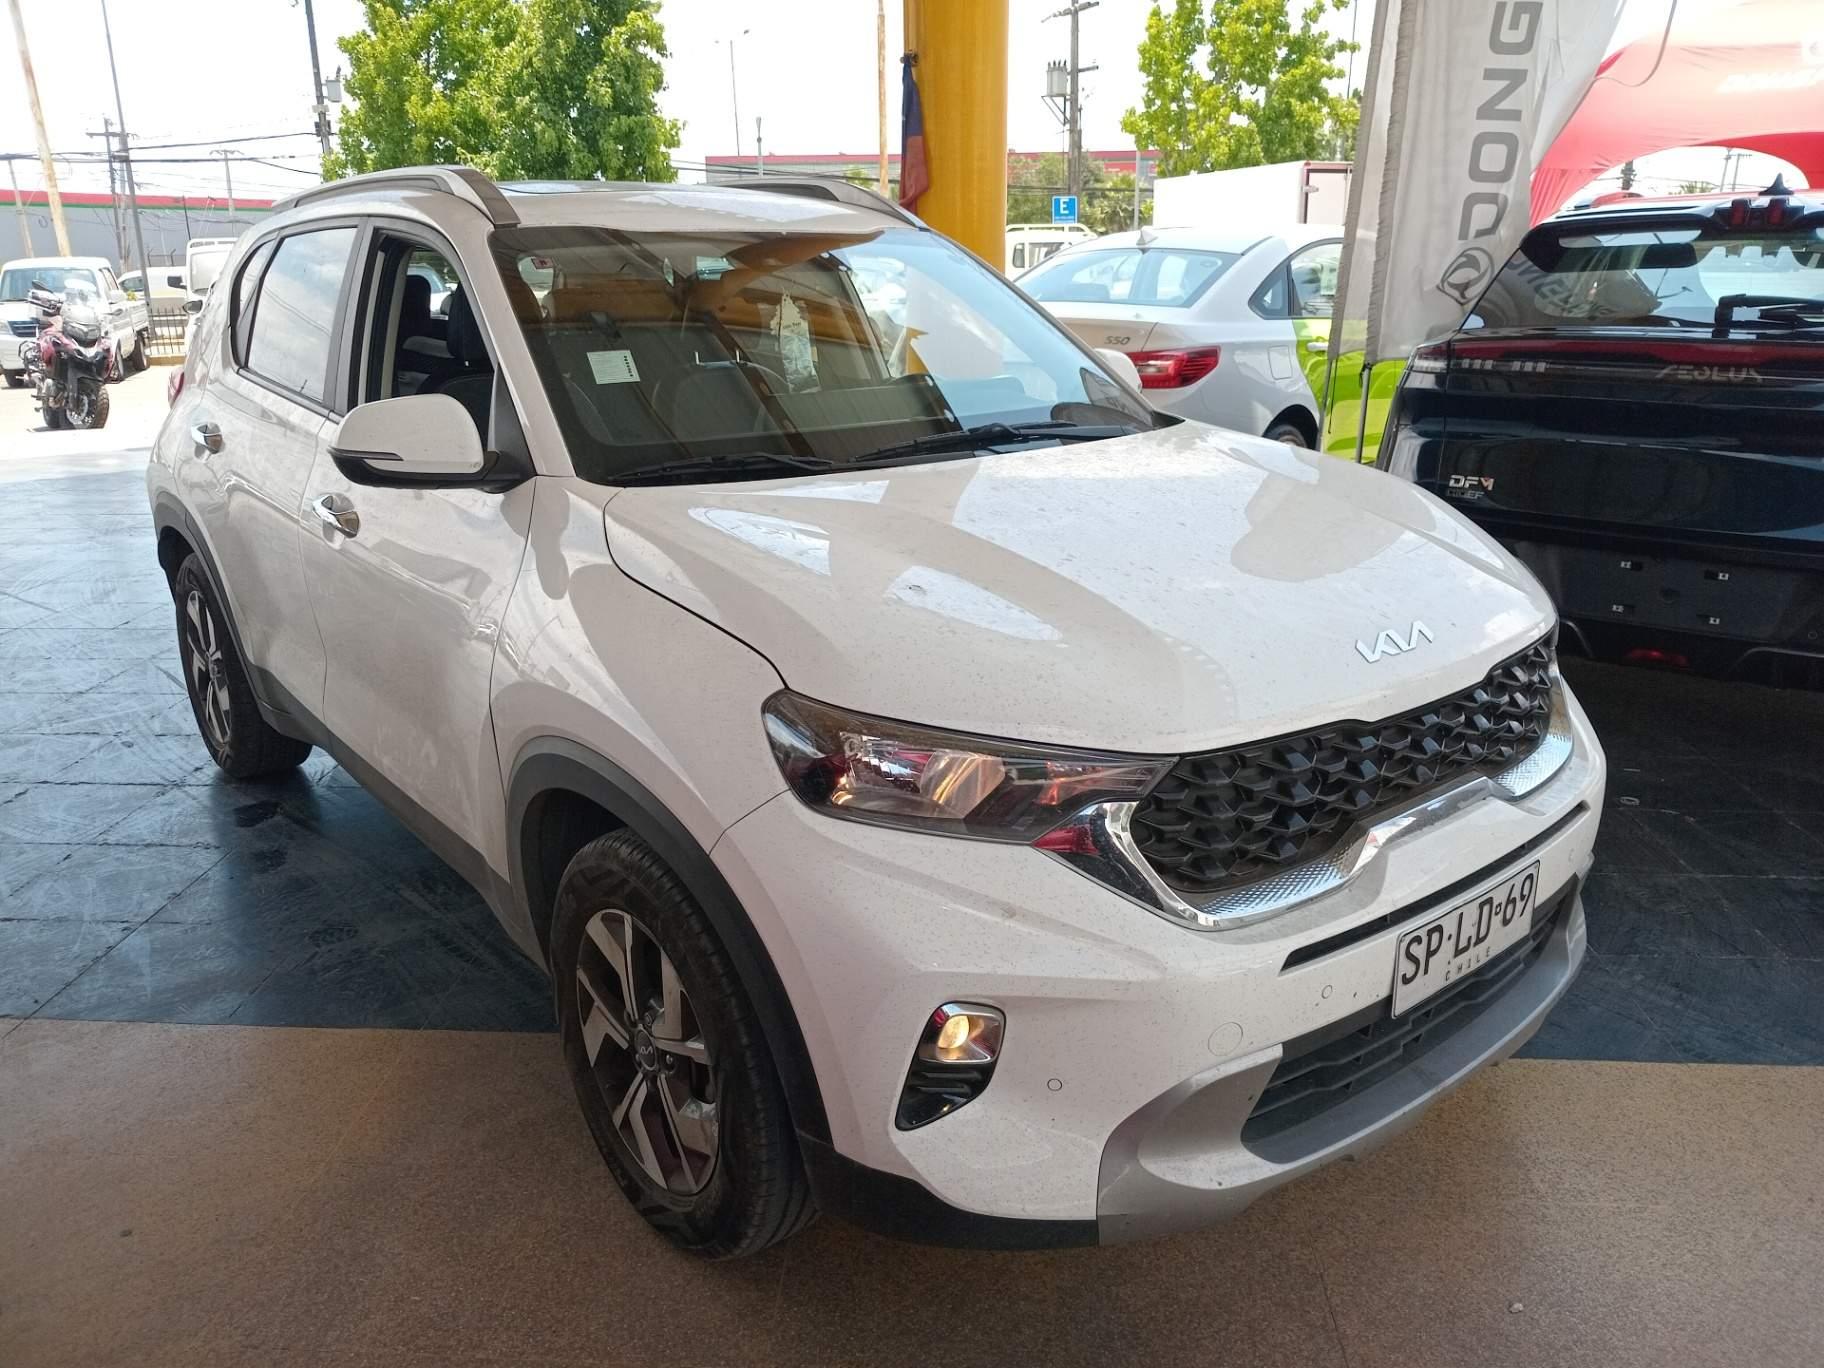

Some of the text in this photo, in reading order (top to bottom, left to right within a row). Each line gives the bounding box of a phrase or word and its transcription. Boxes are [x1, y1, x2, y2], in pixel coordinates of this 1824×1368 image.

[1457, 1, 1544, 241] DONG
[1059, 198, 1070, 214] E
[1355, 620, 1434, 664] KIA
[1446, 946, 1491, 982] CHILE
